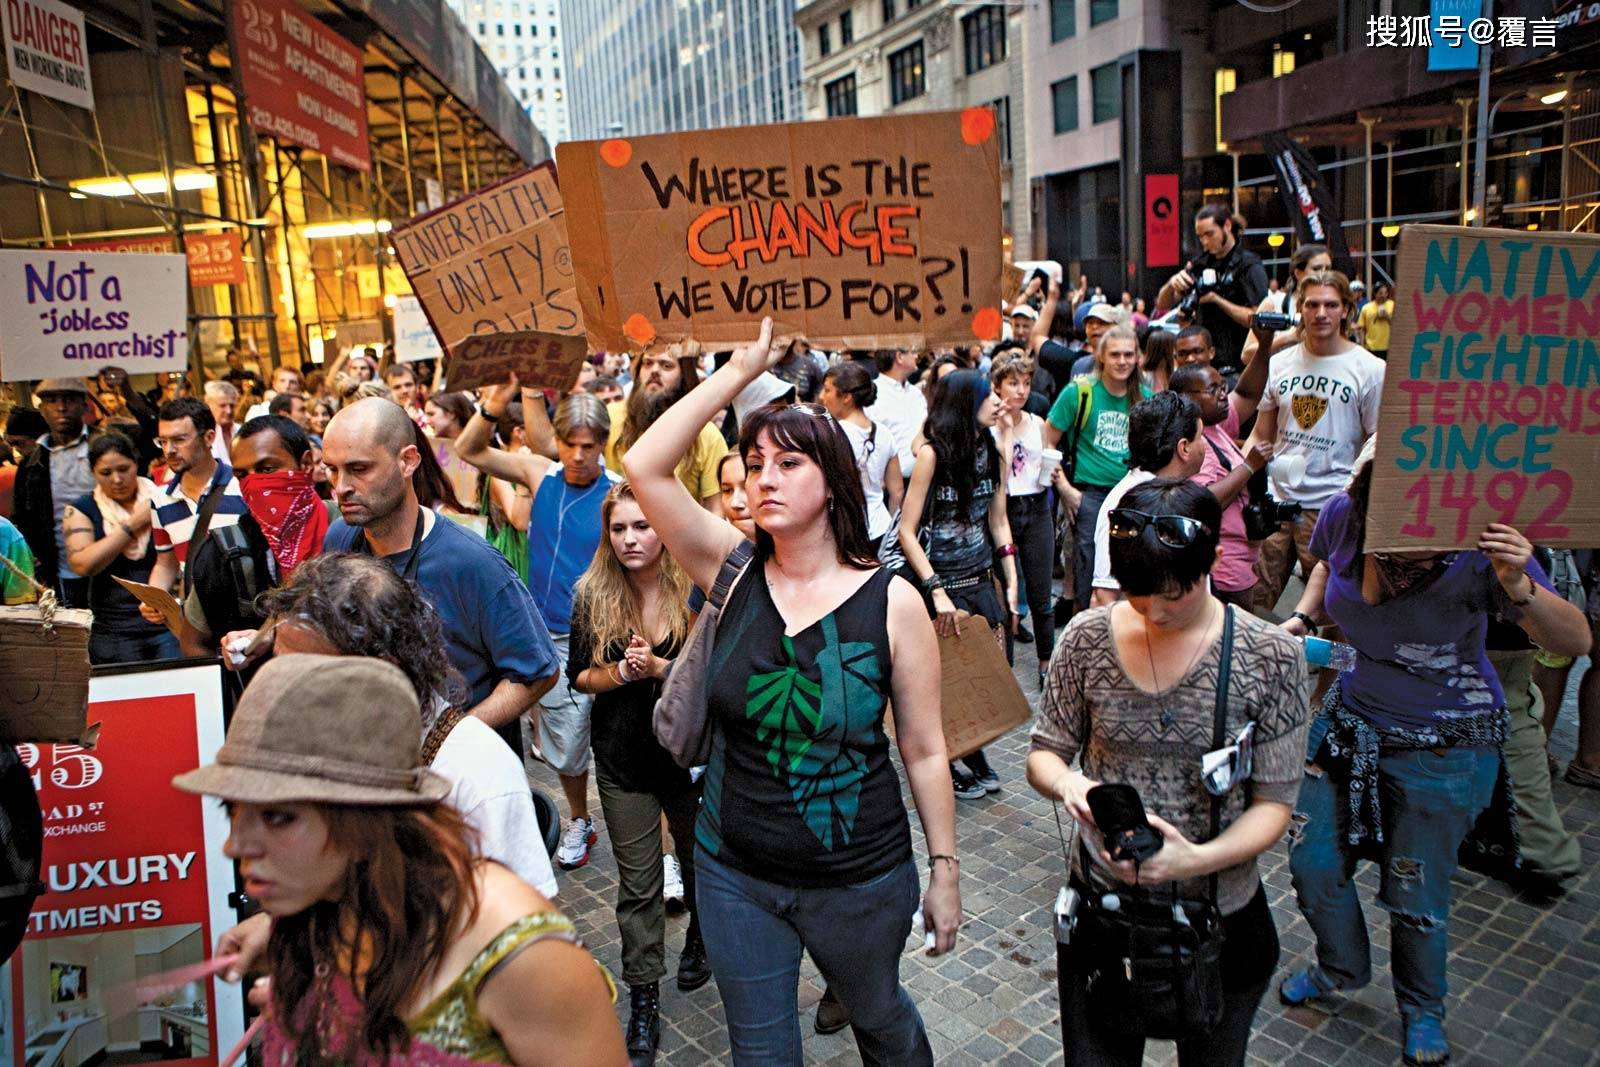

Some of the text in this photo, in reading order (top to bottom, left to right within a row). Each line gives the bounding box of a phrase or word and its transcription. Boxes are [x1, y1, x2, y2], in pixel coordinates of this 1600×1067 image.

[7, 0, 84, 67] DANGER
[1551, 2, 1600, 30] erizo
[641, 156, 934, 209] WHERE IS THE
[400, 181, 549, 271] INTER-FAITH
[686, 200, 921, 270] CHANGE
[189, 240, 233, 264] 25
[437, 234, 545, 315] UNITY
[1423, 237, 1600, 300] NATIV
[24, 261, 122, 304] Not a
[654, 277, 715, 320] WE
[720, 275, 832, 314] VOTED
[1412, 289, 1600, 338] WOMEN
[1409, 331, 1600, 389] FIGHTIN
[1279, 375, 1352, 404] SPORTS
[1398, 380, 1600, 436] TERRORIS
[1395, 423, 1559, 473] SINCE
[1399, 469, 1574, 545] 1492
[41, 804, 84, 821] AD
[43, 821, 107, 839] XCHANGE
[47, 851, 196, 893] UXURY
[25, 899, 163, 934] TMENTS
